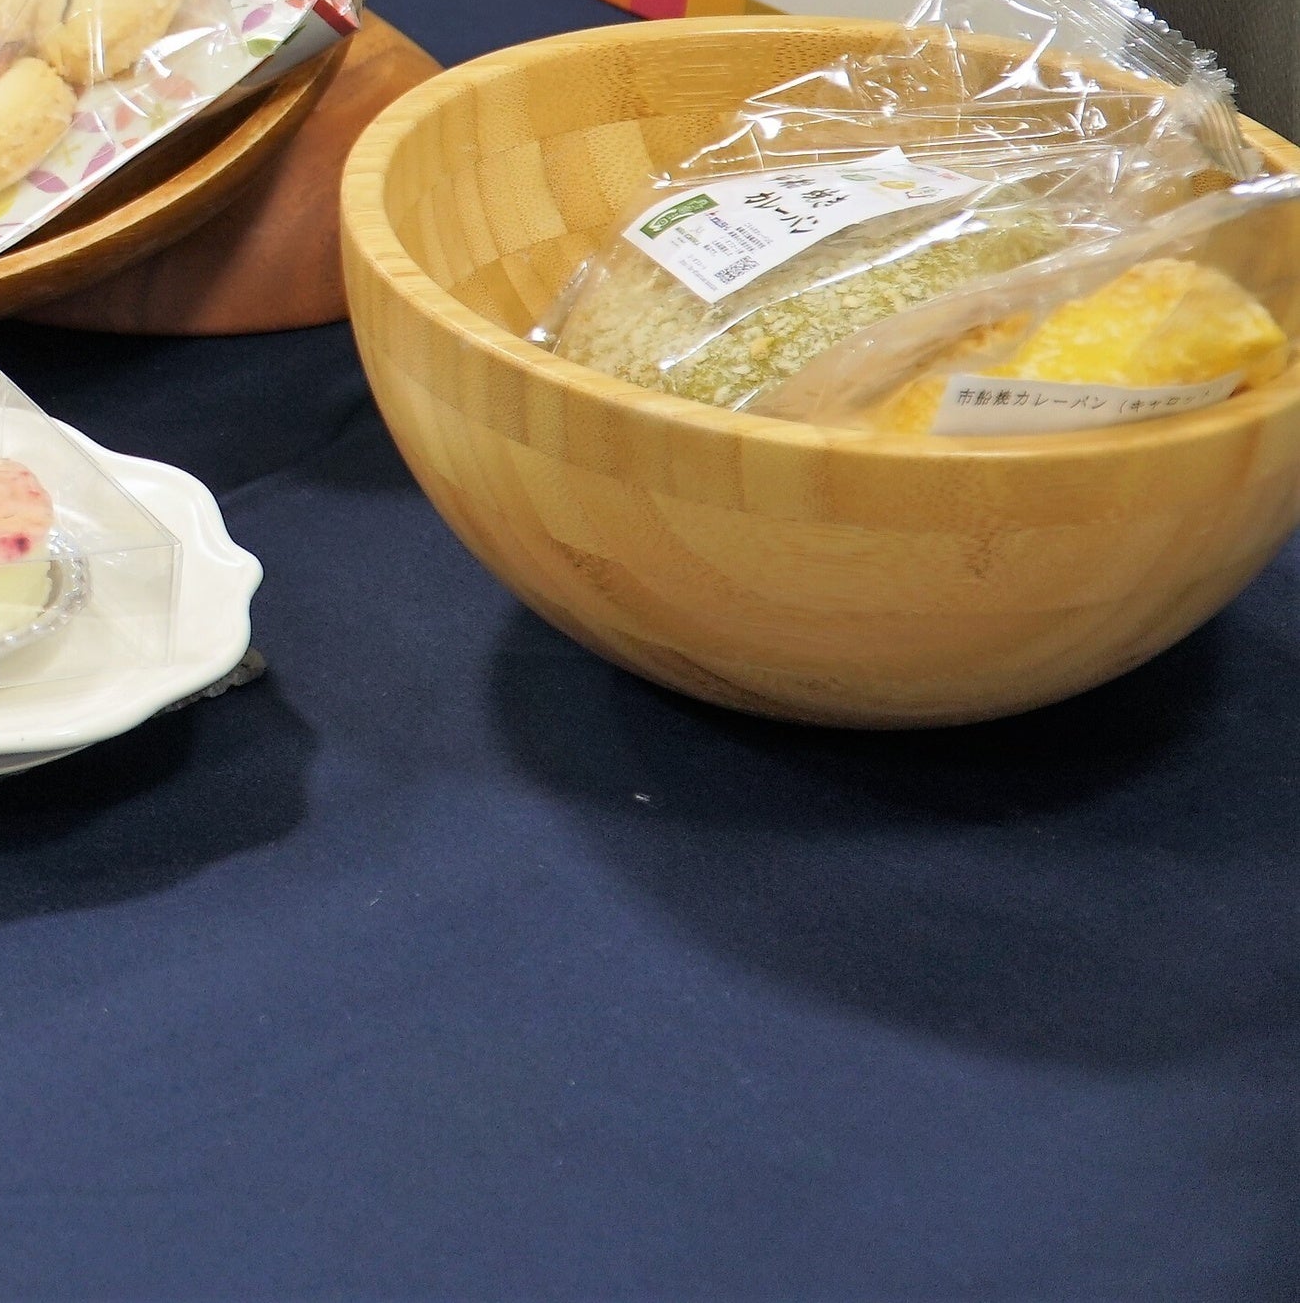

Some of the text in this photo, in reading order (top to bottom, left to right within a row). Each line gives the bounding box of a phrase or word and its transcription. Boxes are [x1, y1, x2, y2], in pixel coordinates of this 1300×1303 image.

[743, 190, 819, 235] カレーパン
